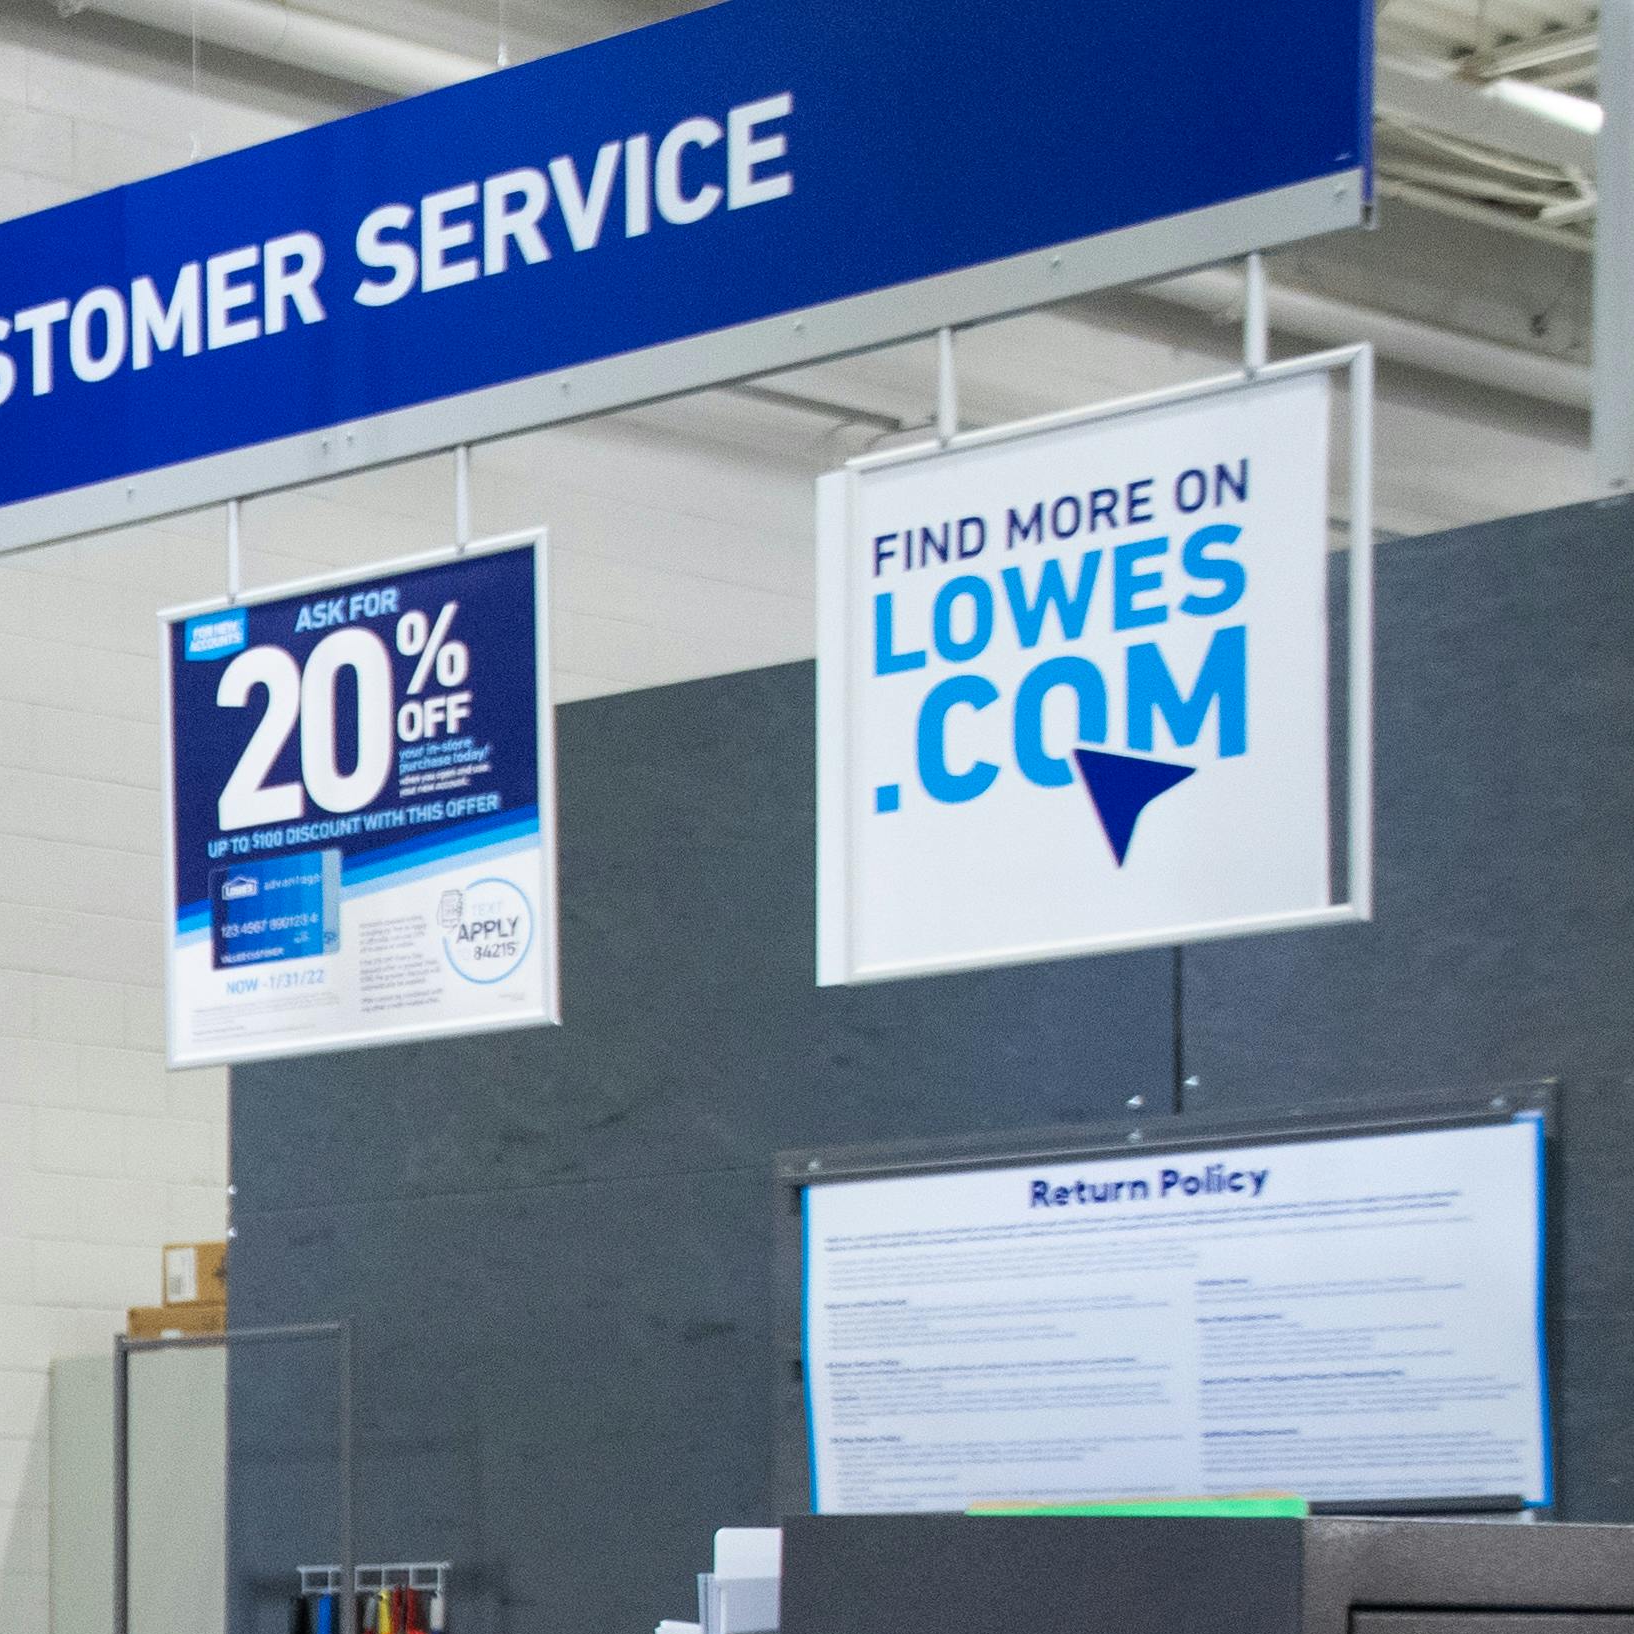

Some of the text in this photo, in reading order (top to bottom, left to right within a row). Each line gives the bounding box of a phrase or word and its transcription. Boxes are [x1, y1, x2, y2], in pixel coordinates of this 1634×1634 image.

[353, 90, 794, 307] SERVICE
[873, 458, 1249, 577] FIND MORE ON
[295, 587, 399, 633] ASK FOR
[873, 524, 1247, 677] LOWES
[397, 691, 472, 742] OFF
[873, 624, 1248, 815] .COM
[399, 755, 452, 776] purchase
[208, 793, 499, 858] UP TO $100 DISCOUNT WITH THIS OFFER
[457, 916, 519, 943] APPLY
[474, 942, 517, 960] 84215
[226, 976, 258, 993] NOW
[1028, 1163, 1269, 1208] Return Policy
